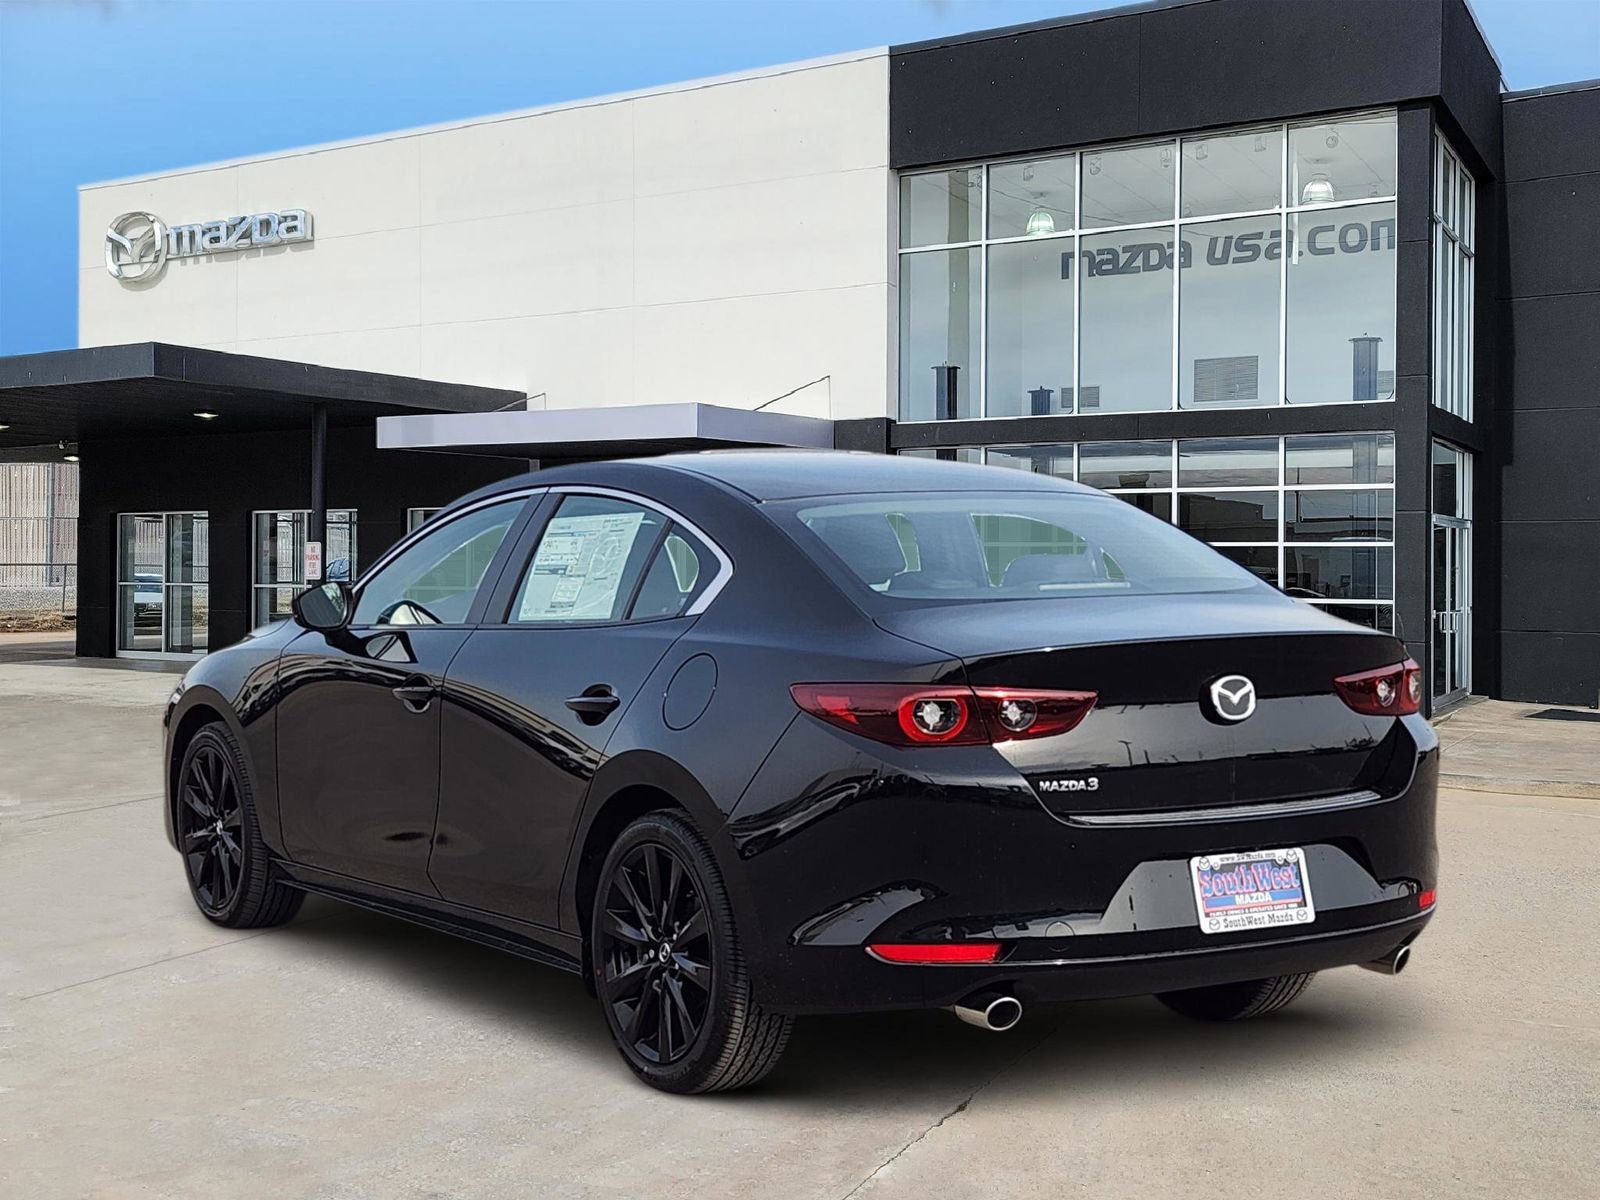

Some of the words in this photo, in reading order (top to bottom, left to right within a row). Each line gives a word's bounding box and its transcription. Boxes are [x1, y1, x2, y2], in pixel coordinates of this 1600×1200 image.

[165, 208, 312, 257] mazda
[1060, 239, 1192, 279] mazda
[1039, 777, 1099, 791] MAZDA3
[1199, 861, 1301, 897] SouthWest
[1235, 891, 1273, 905] MAZDA
[1223, 914, 1266, 929] SouthWest
[1267, 913, 1294, 925] Mazda
